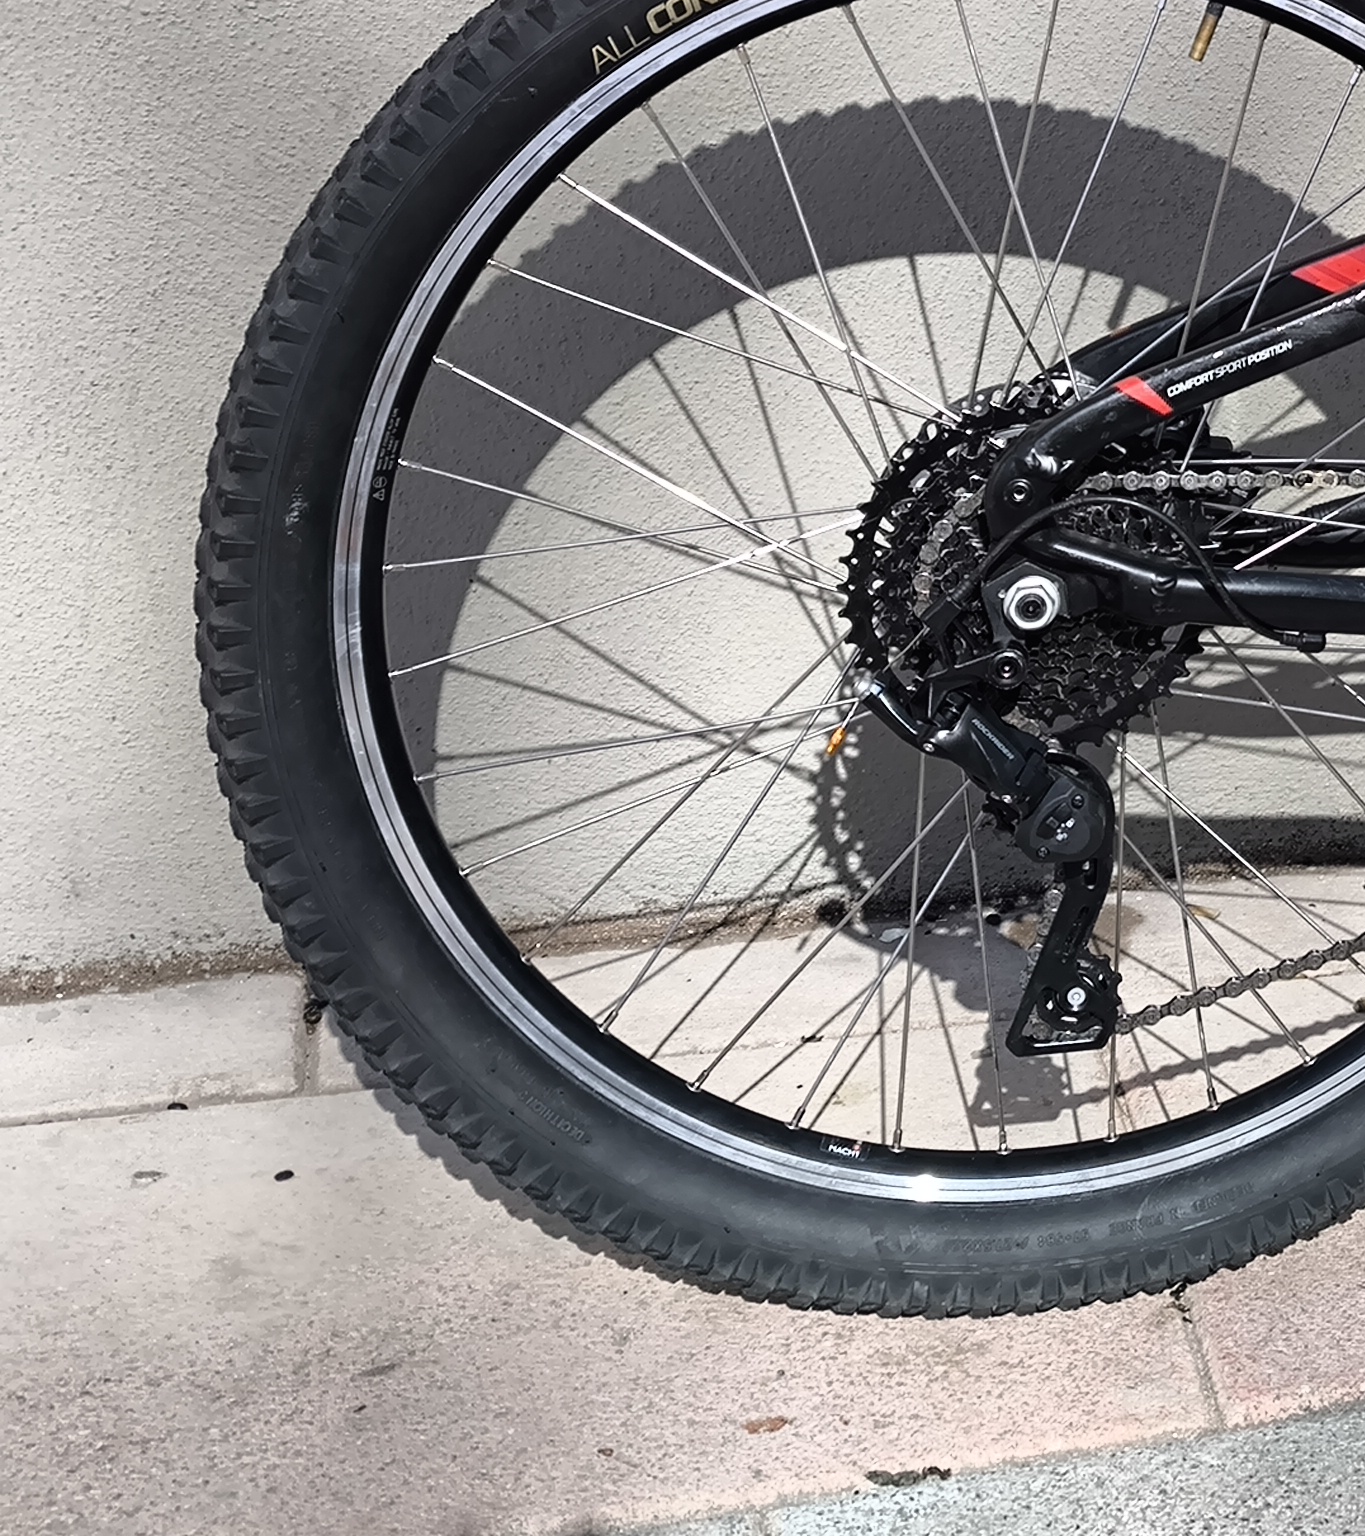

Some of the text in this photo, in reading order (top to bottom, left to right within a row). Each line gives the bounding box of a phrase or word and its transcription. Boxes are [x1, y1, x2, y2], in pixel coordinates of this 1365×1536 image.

[589, 24, 651, 75] ALL
[1166, 339, 1294, 398] COMFORT SPORT POSITION
